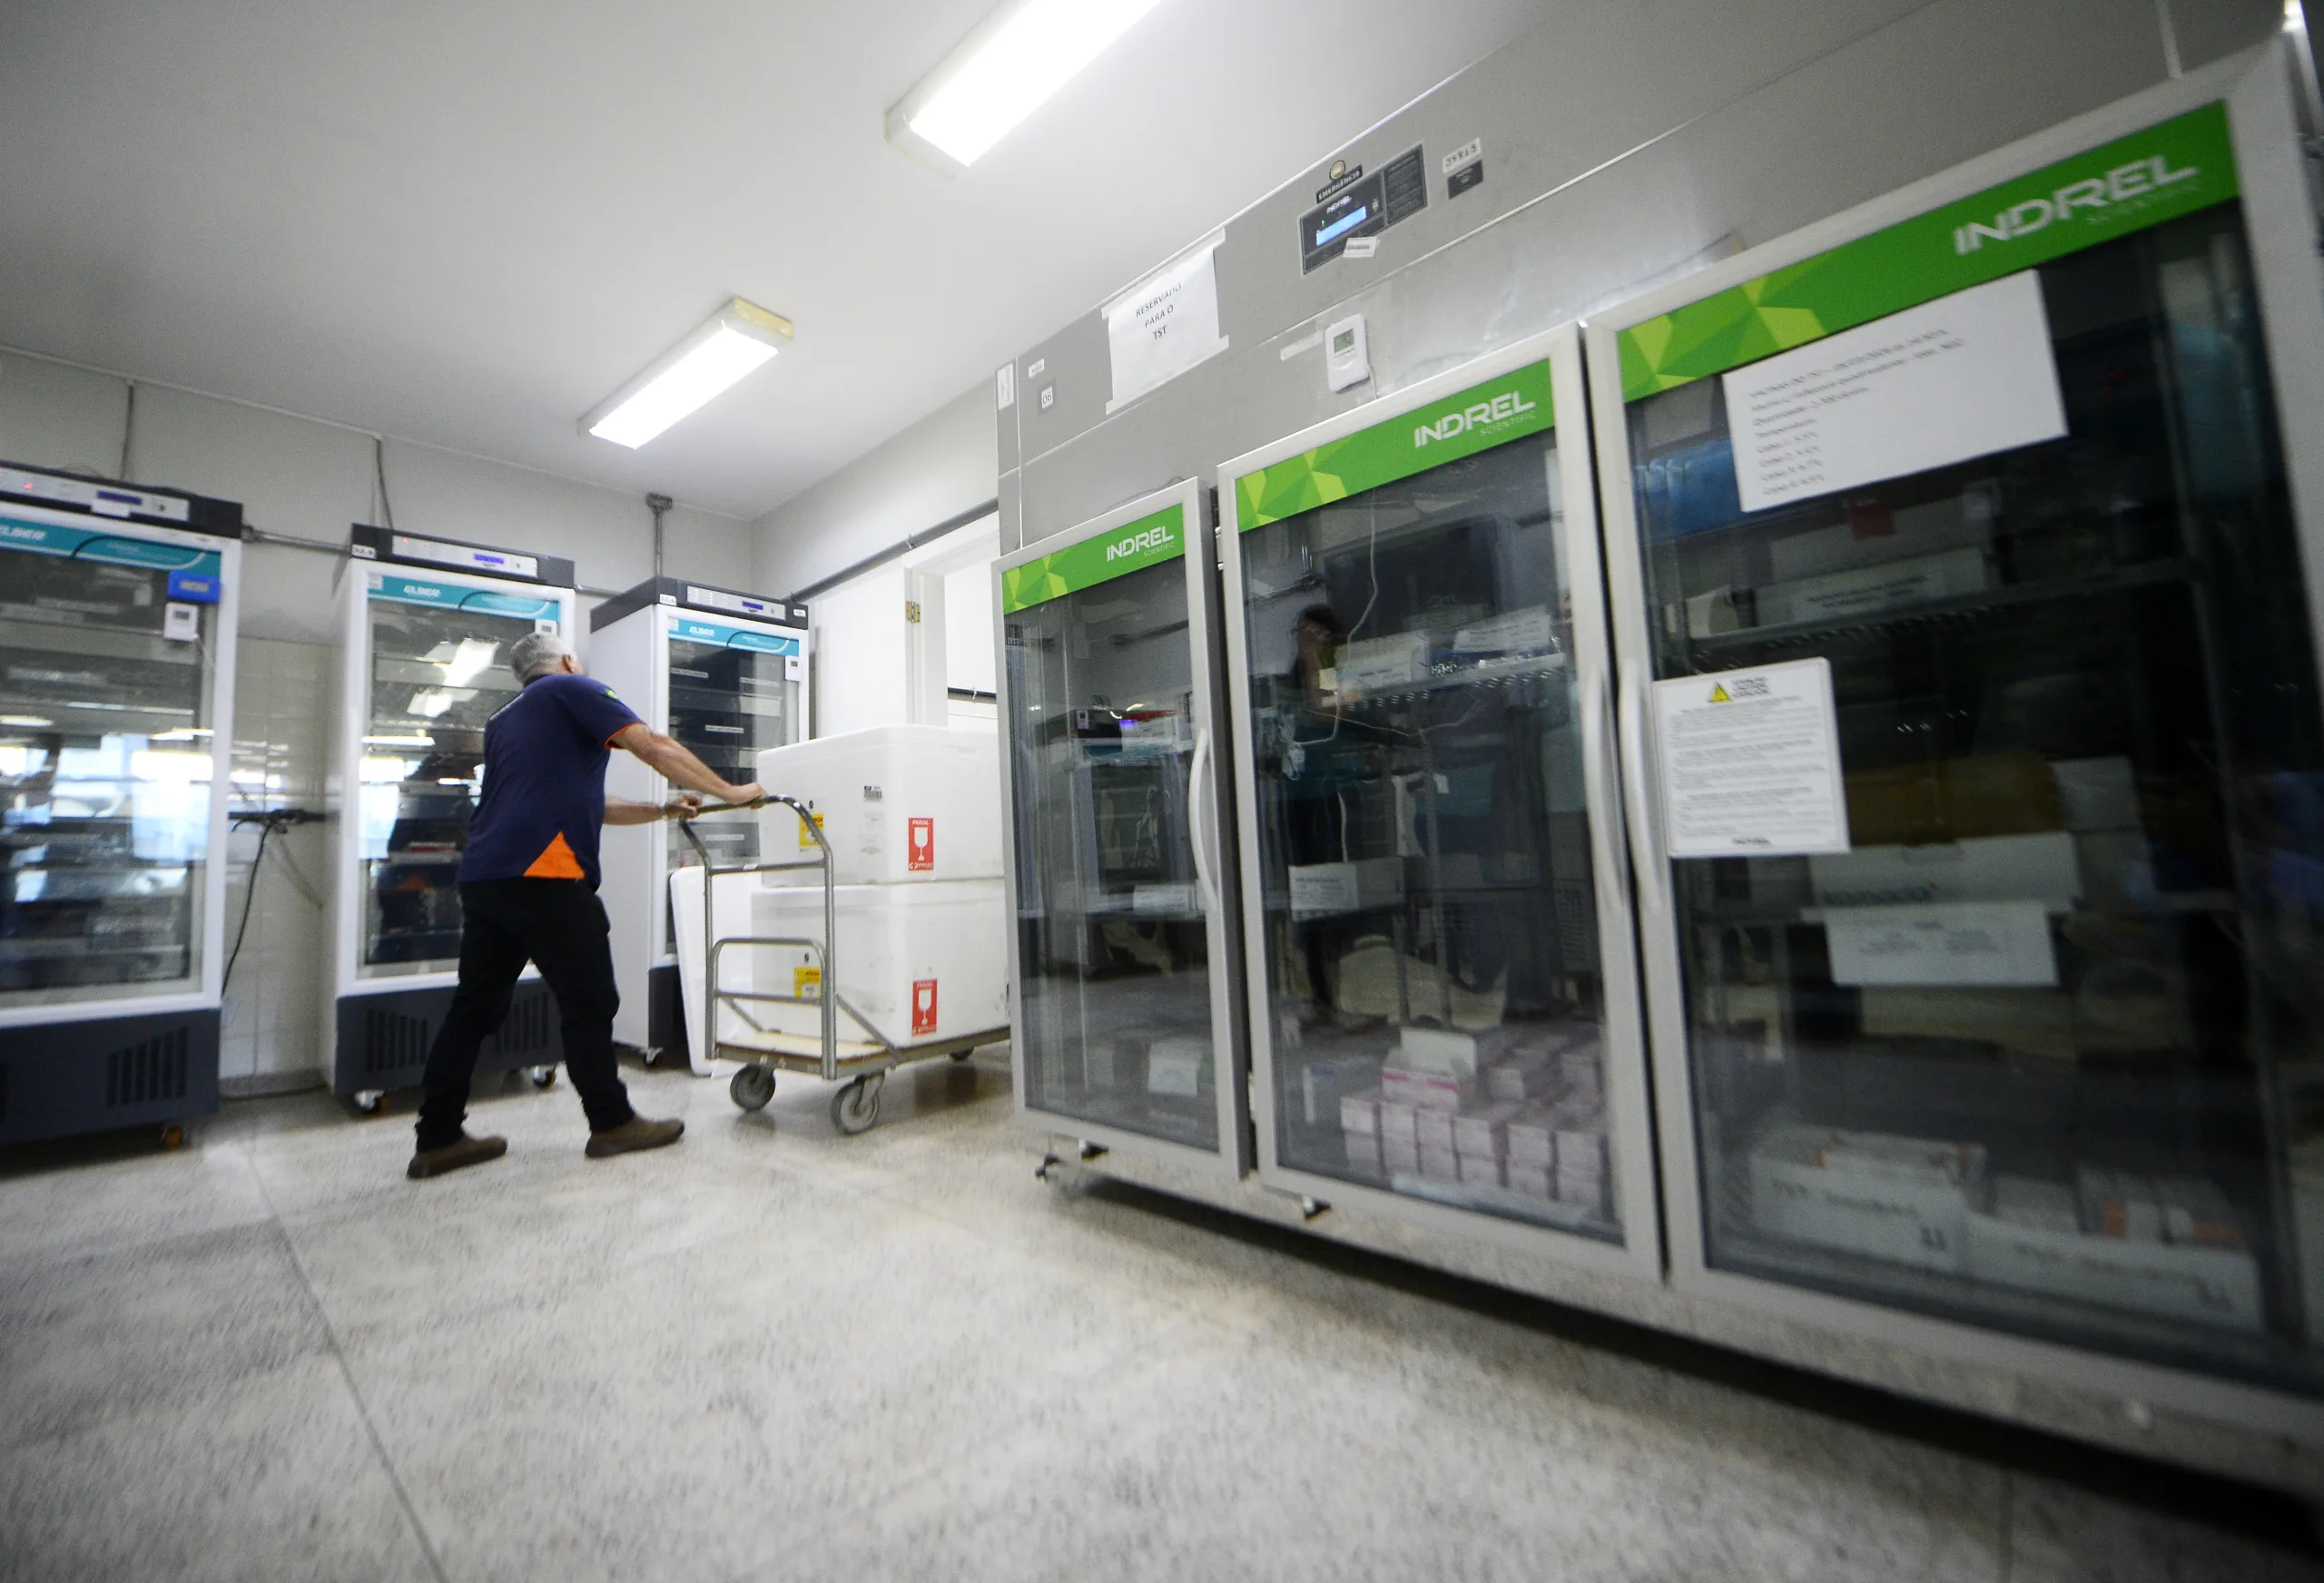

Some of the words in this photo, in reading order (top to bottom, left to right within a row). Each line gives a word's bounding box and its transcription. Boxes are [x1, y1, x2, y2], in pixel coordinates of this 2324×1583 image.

[1954, 154, 2201, 256] INDREL
[1136, 282, 1181, 318] RESERVADO
[1145, 310, 1166, 329] PARA
[1167, 304, 1174, 314] O
[1153, 324, 1167, 340] TST
[1042, 393, 1052, 405] 06
[1413, 390, 1537, 448] INDREL
[1107, 525, 1175, 562] INDREL
